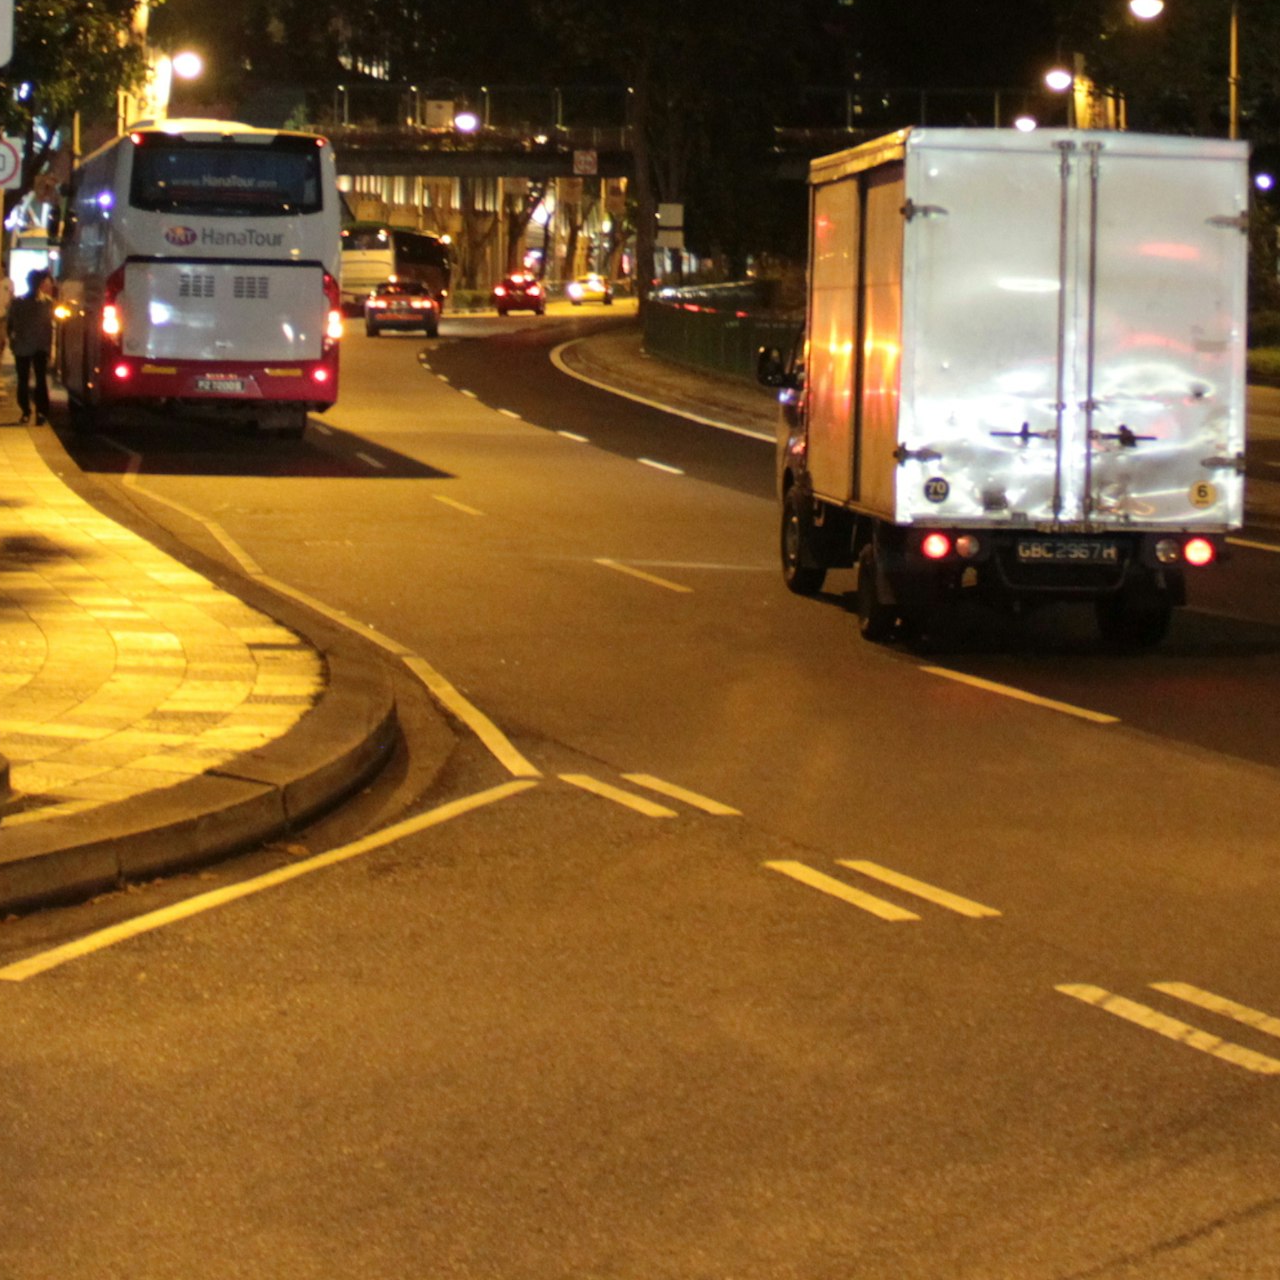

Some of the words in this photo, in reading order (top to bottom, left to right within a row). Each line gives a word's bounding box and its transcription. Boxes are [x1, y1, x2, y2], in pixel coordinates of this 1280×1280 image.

[201, 228, 284, 246] HanaTour
[928, 482, 946, 494] 70
[1197, 485, 1208, 498] 6
